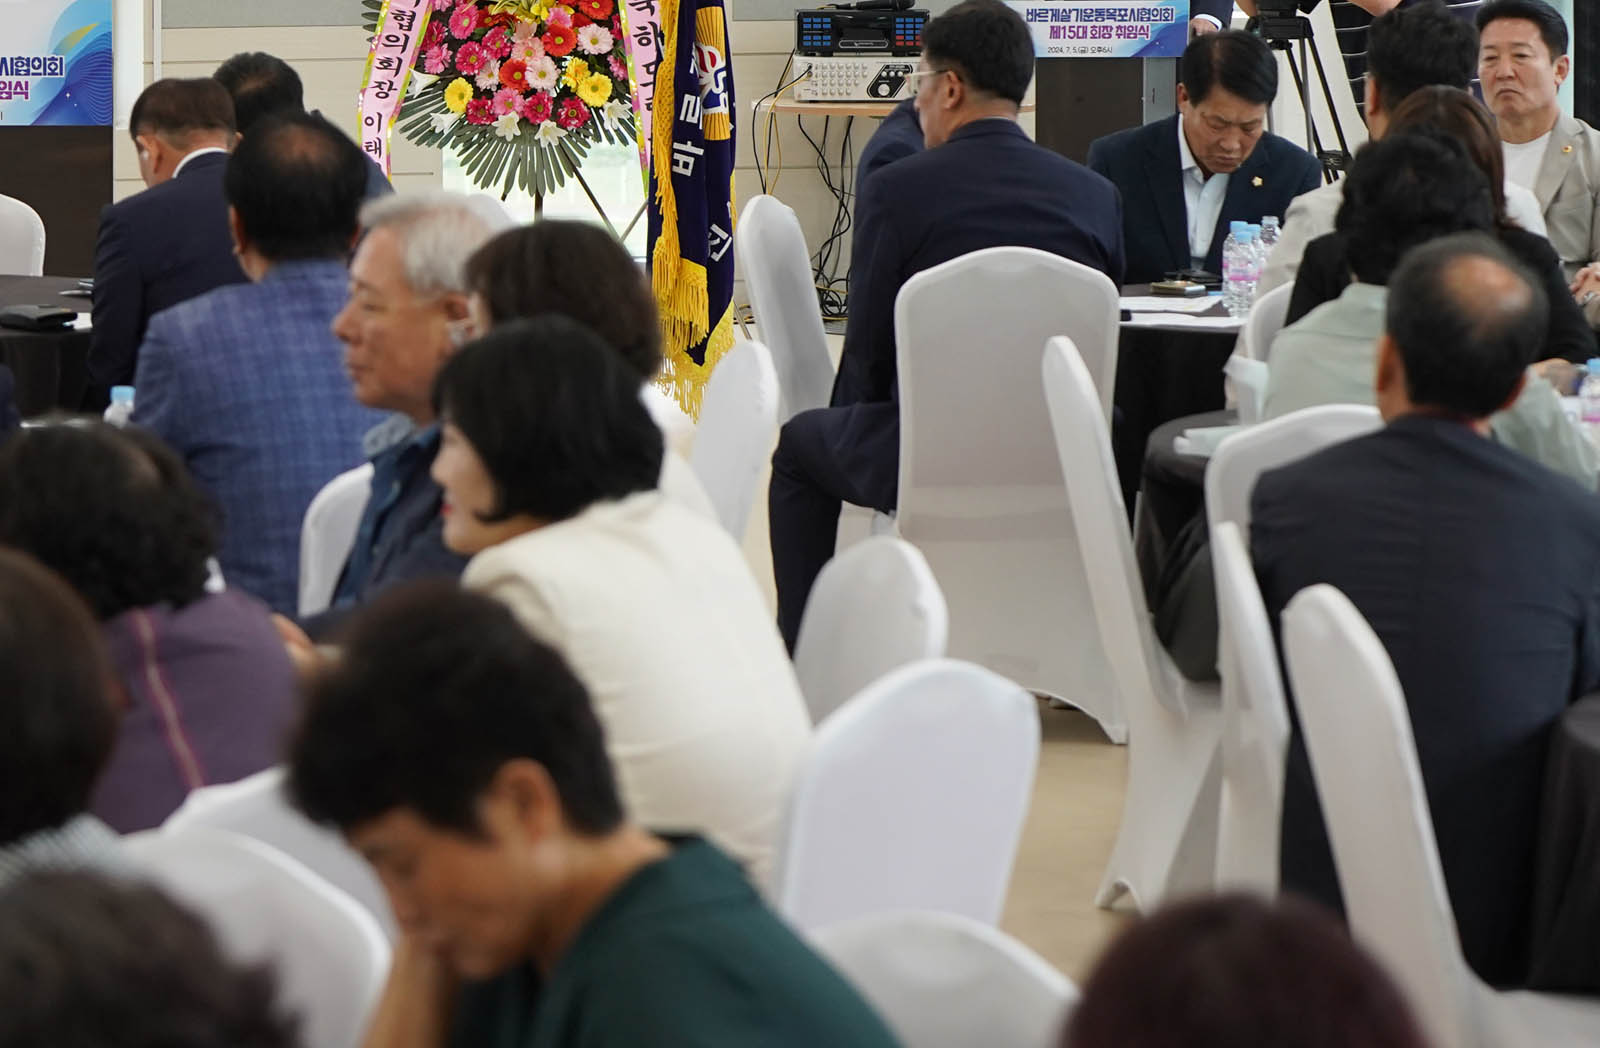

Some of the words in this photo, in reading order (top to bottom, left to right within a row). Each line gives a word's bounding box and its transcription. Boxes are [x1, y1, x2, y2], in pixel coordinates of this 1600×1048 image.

[1026, 8, 1173, 22] 바르게살기운동목포시협의회
[1050, 25, 1087, 39] 제15대
[1090, 25, 1113, 39] 회장
[1116, 25, 1150, 39] 취임식
[364, 112, 383, 168] 이태
